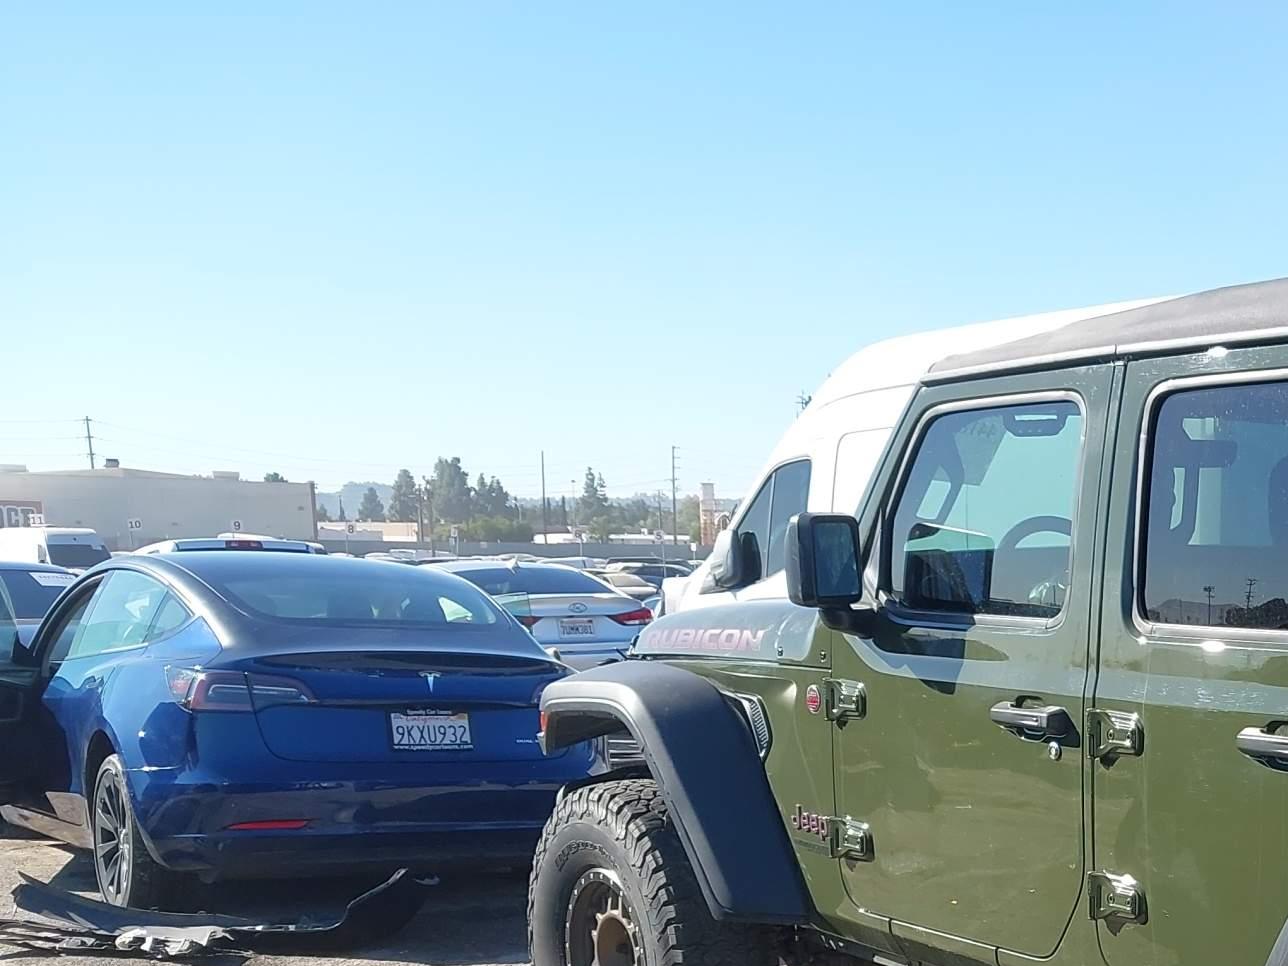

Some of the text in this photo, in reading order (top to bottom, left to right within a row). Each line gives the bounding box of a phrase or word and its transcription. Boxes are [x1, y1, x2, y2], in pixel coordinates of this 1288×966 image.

[128, 520, 142, 529] 10
[233, 520, 241, 531] 9
[347, 524, 355, 533] 8
[655, 531, 662, 540] 5
[645, 628, 768, 651] RUBICON
[396, 725, 468, 744] 9KXU932
[791, 804, 828, 841] Jeep
